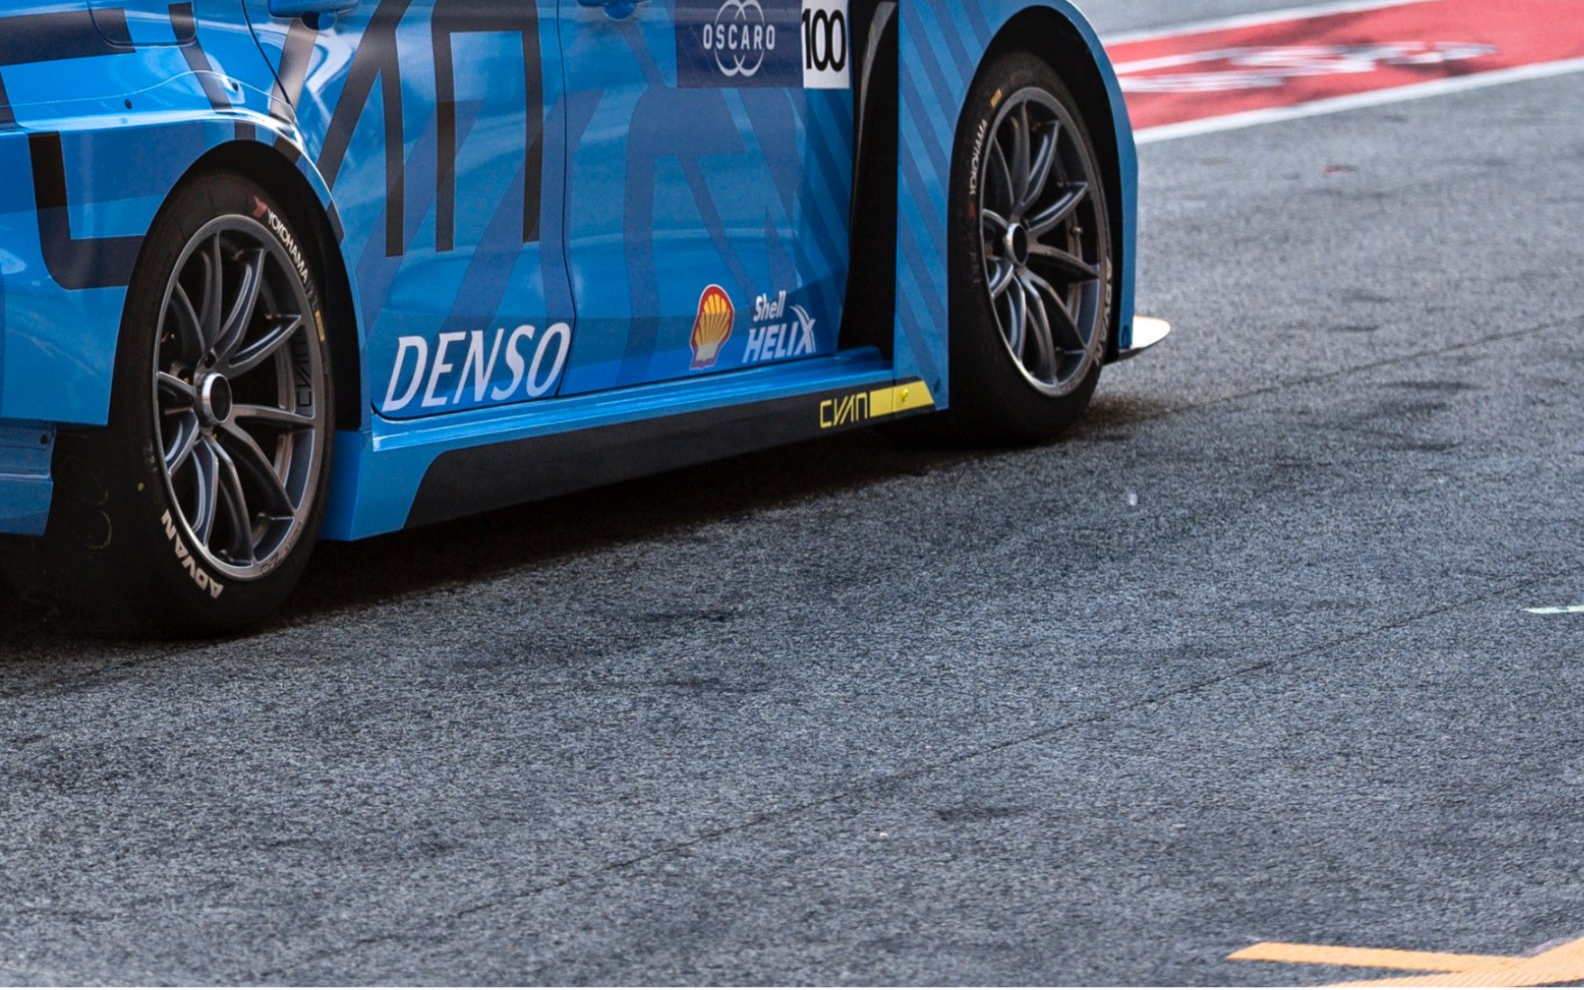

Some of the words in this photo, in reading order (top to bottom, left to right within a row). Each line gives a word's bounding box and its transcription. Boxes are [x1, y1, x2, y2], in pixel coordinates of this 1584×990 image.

[703, 23, 776, 51] OSCARO
[802, 8, 847, 73] 100
[267, 209, 309, 284] YOKOHAMA
[741, 304, 817, 364] HELIX
[753, 290, 787, 322] Shell
[382, 322, 572, 411] DENSO
[160, 508, 224, 599] ADVAN
